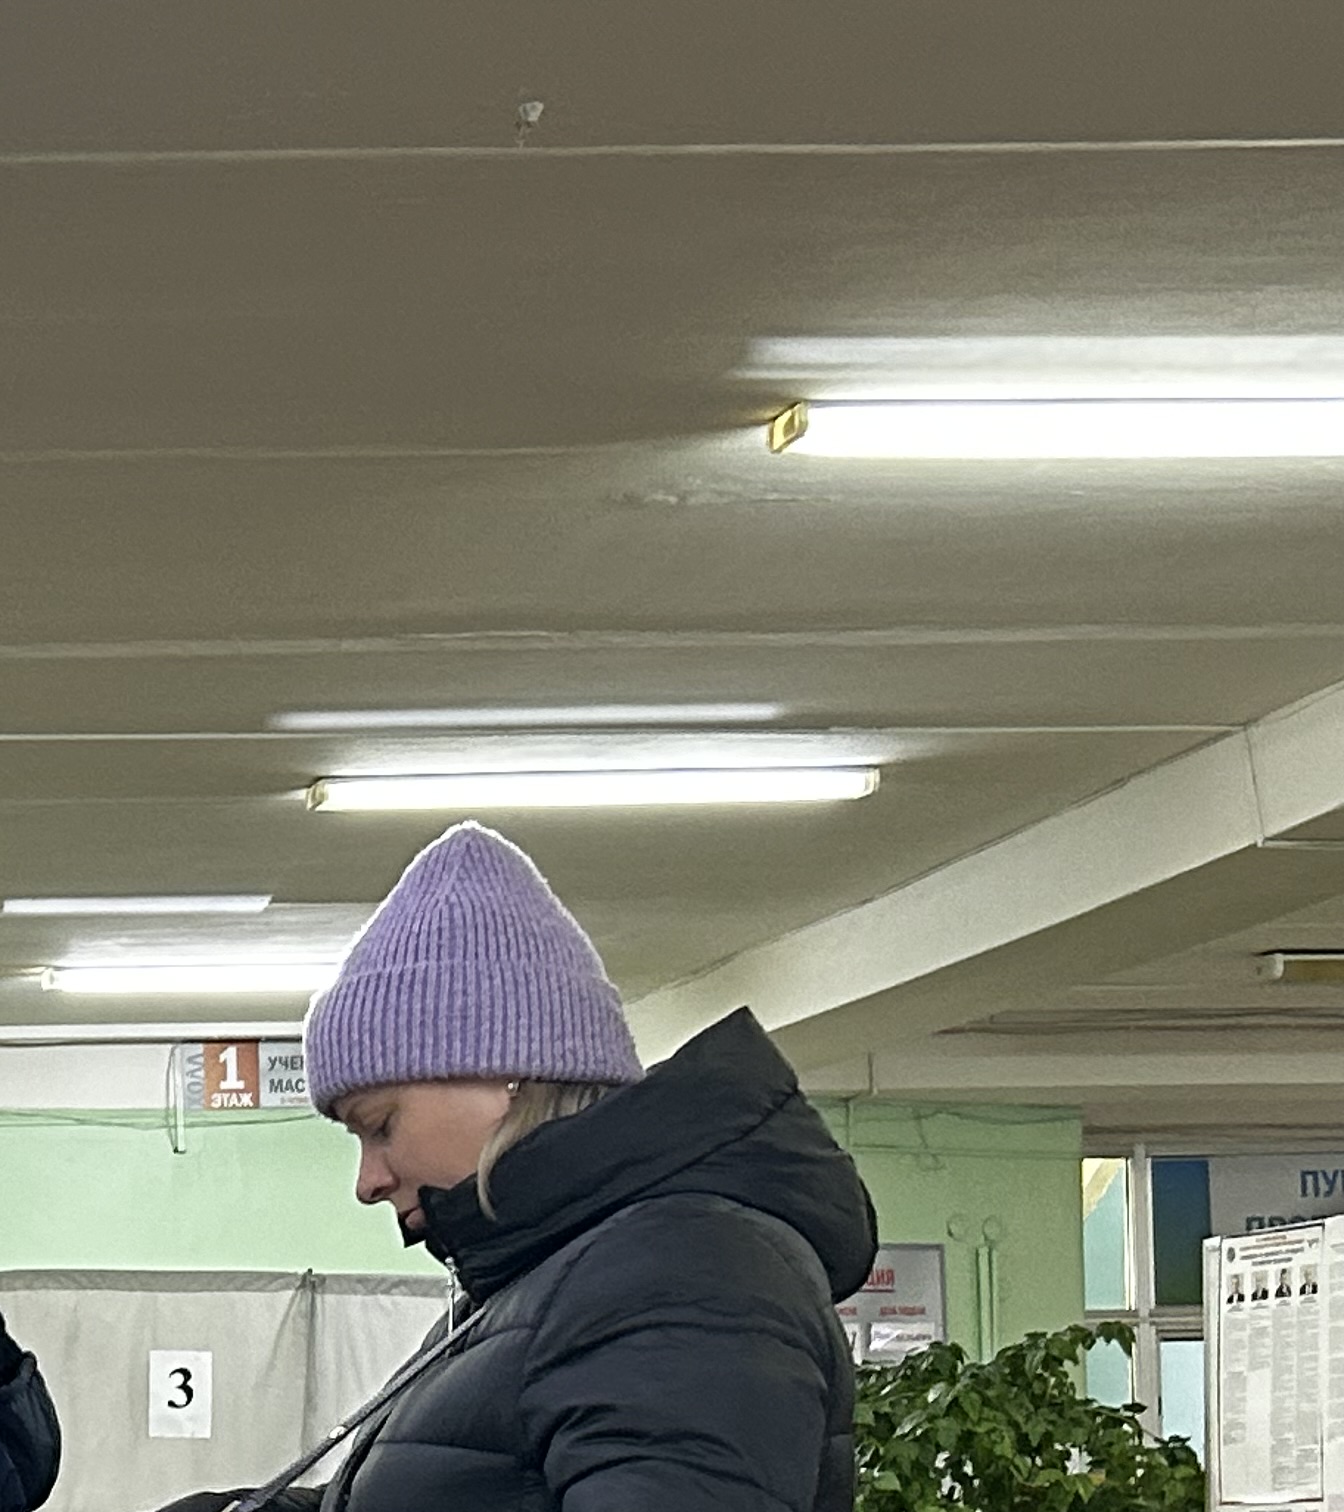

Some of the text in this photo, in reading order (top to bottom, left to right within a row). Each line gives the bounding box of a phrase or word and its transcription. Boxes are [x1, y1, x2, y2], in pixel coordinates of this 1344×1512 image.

[218, 1046, 245, 1090] 1
[210, 1092, 254, 1108] ЭТАЖ
[1300, 1169, 1344, 1198] ПУ
[167, 1366, 194, 1410] 3
